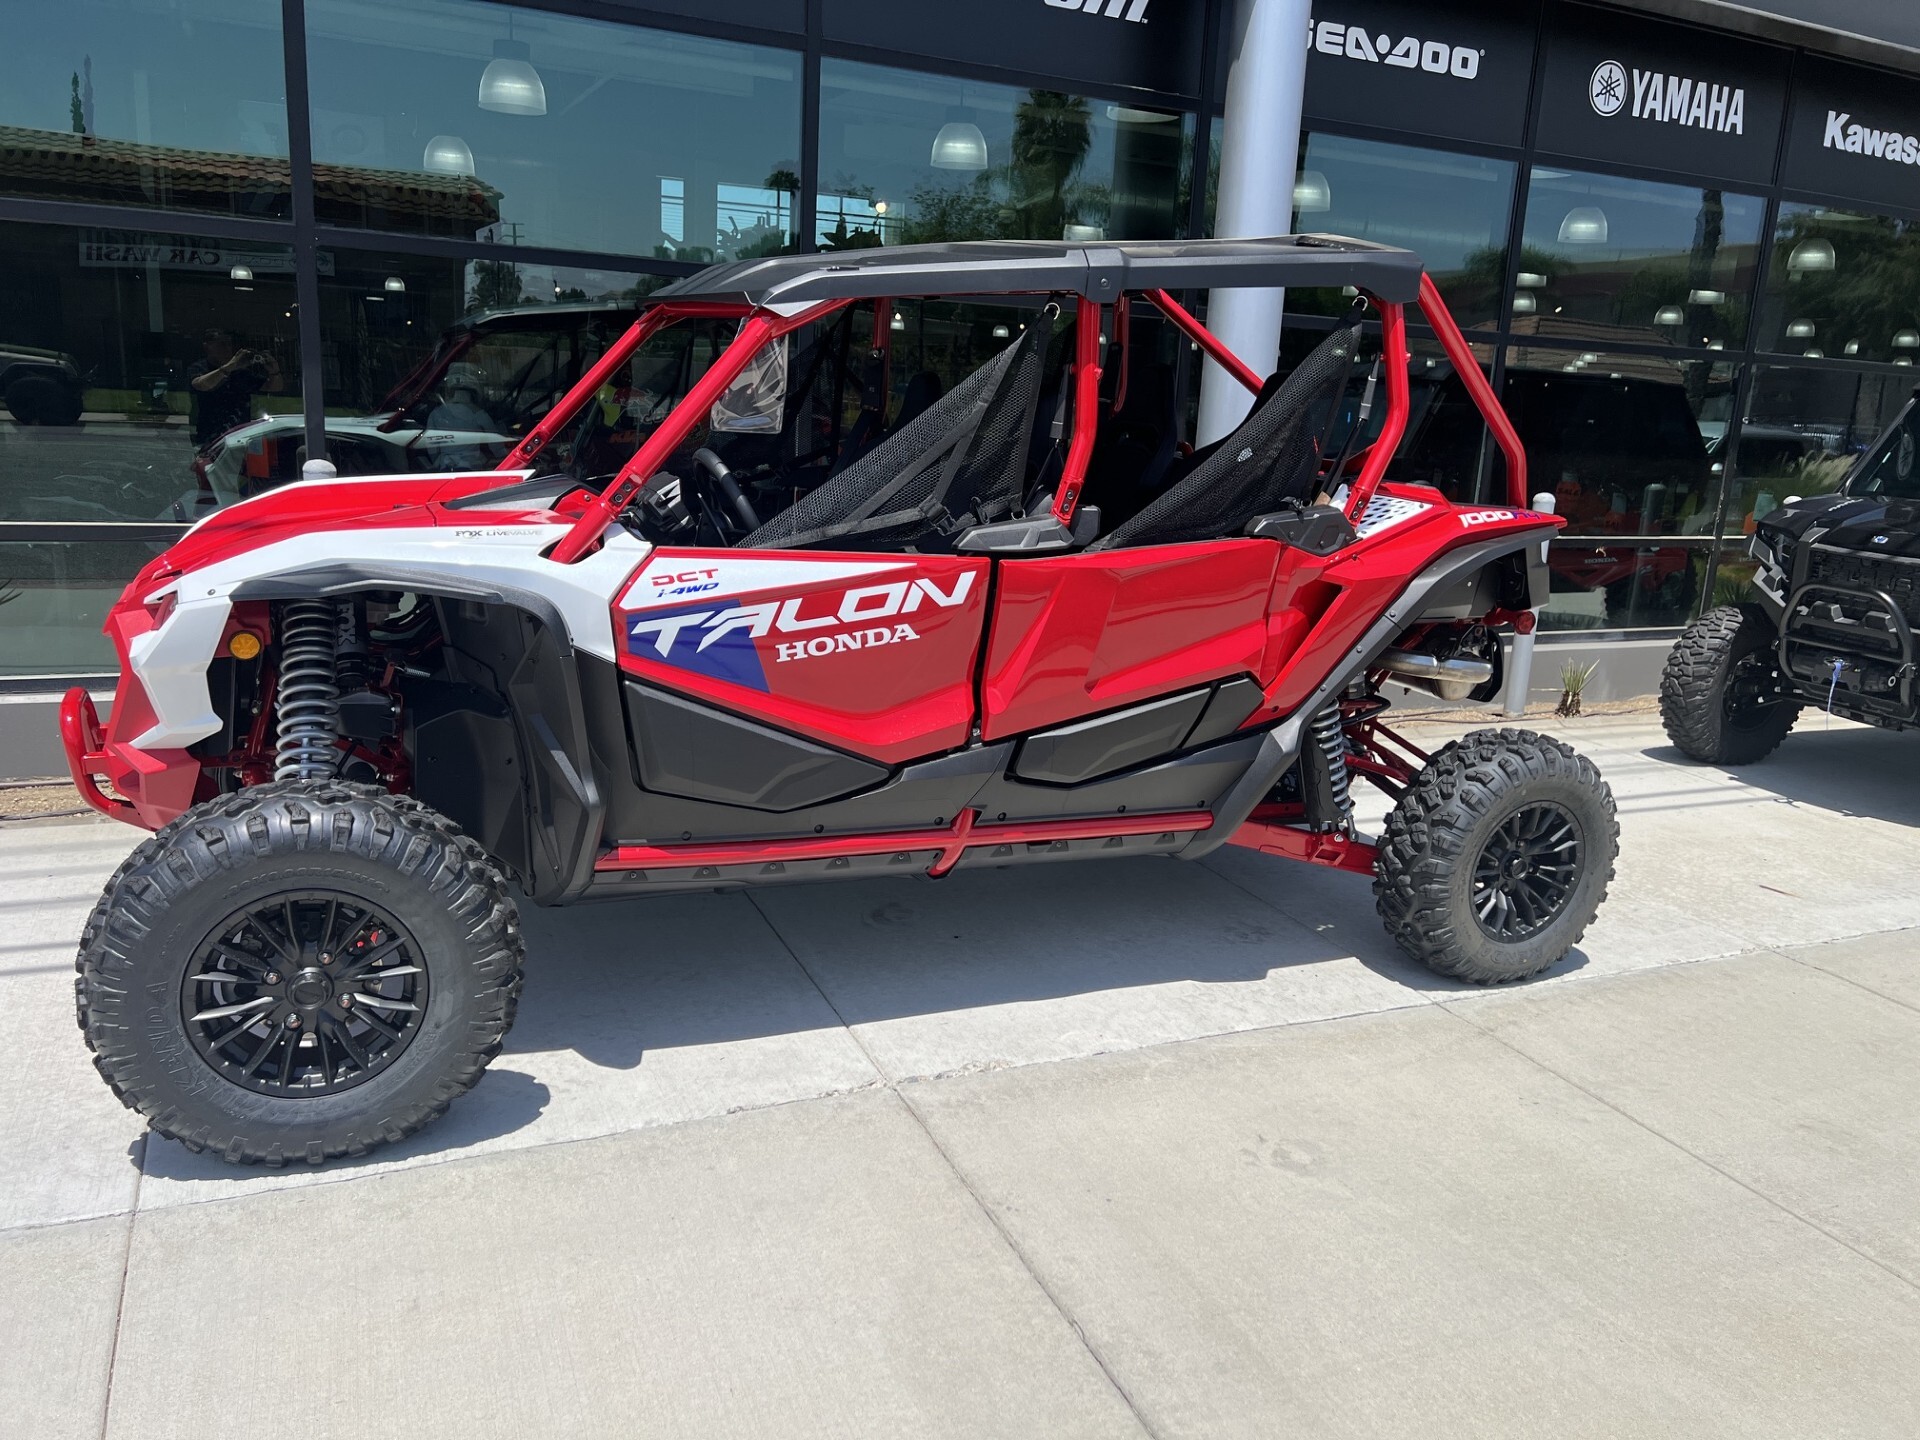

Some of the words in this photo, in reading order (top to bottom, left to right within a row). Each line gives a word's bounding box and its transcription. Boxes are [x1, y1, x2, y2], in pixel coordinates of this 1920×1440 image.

[1632, 68, 1744, 135] YAMAHA
[1823, 110, 1920, 167] Kawas
[651, 568, 719, 587] DCT
[1584, 556, 1618, 564] HONDA
[331, 602, 357, 647] FOX
[630, 570, 977, 658] TALON
[775, 624, 920, 663] HONDA
